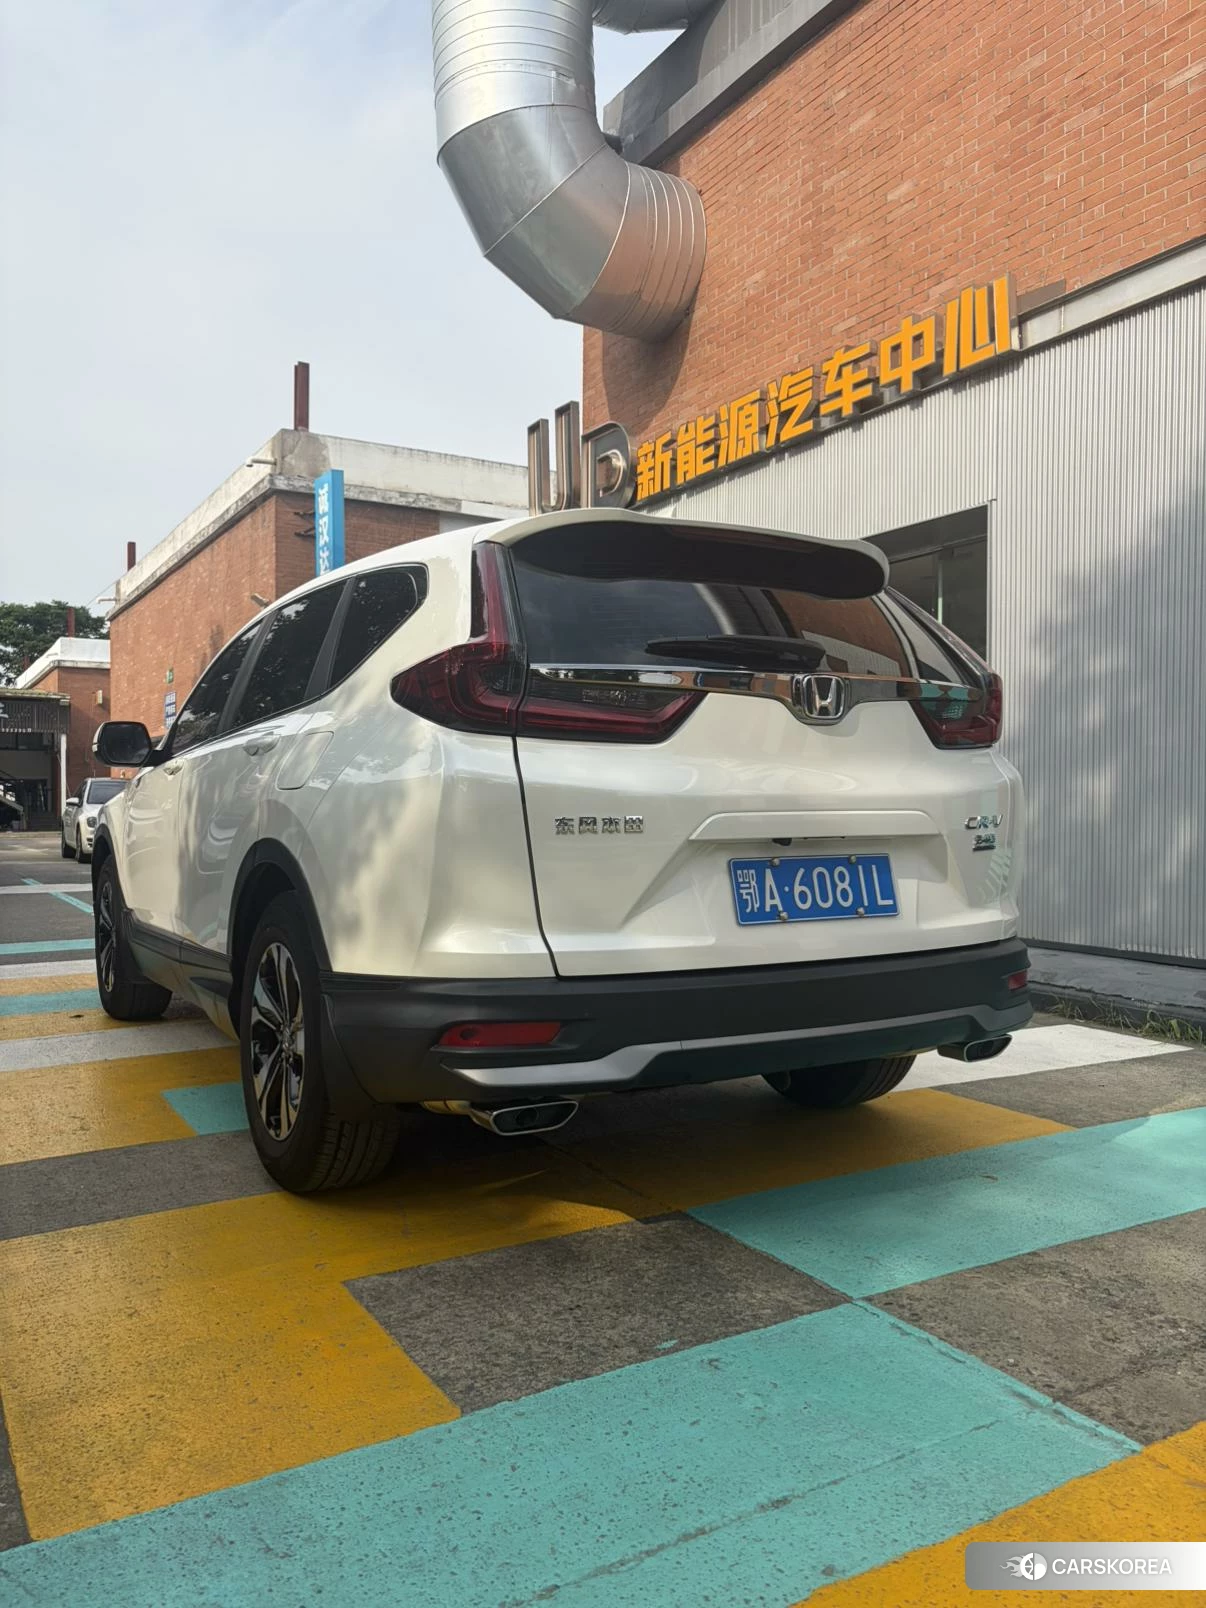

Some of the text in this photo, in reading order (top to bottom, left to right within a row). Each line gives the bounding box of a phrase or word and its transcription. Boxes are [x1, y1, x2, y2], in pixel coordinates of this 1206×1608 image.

[636, 274, 1013, 501] 新能源汽车中心
